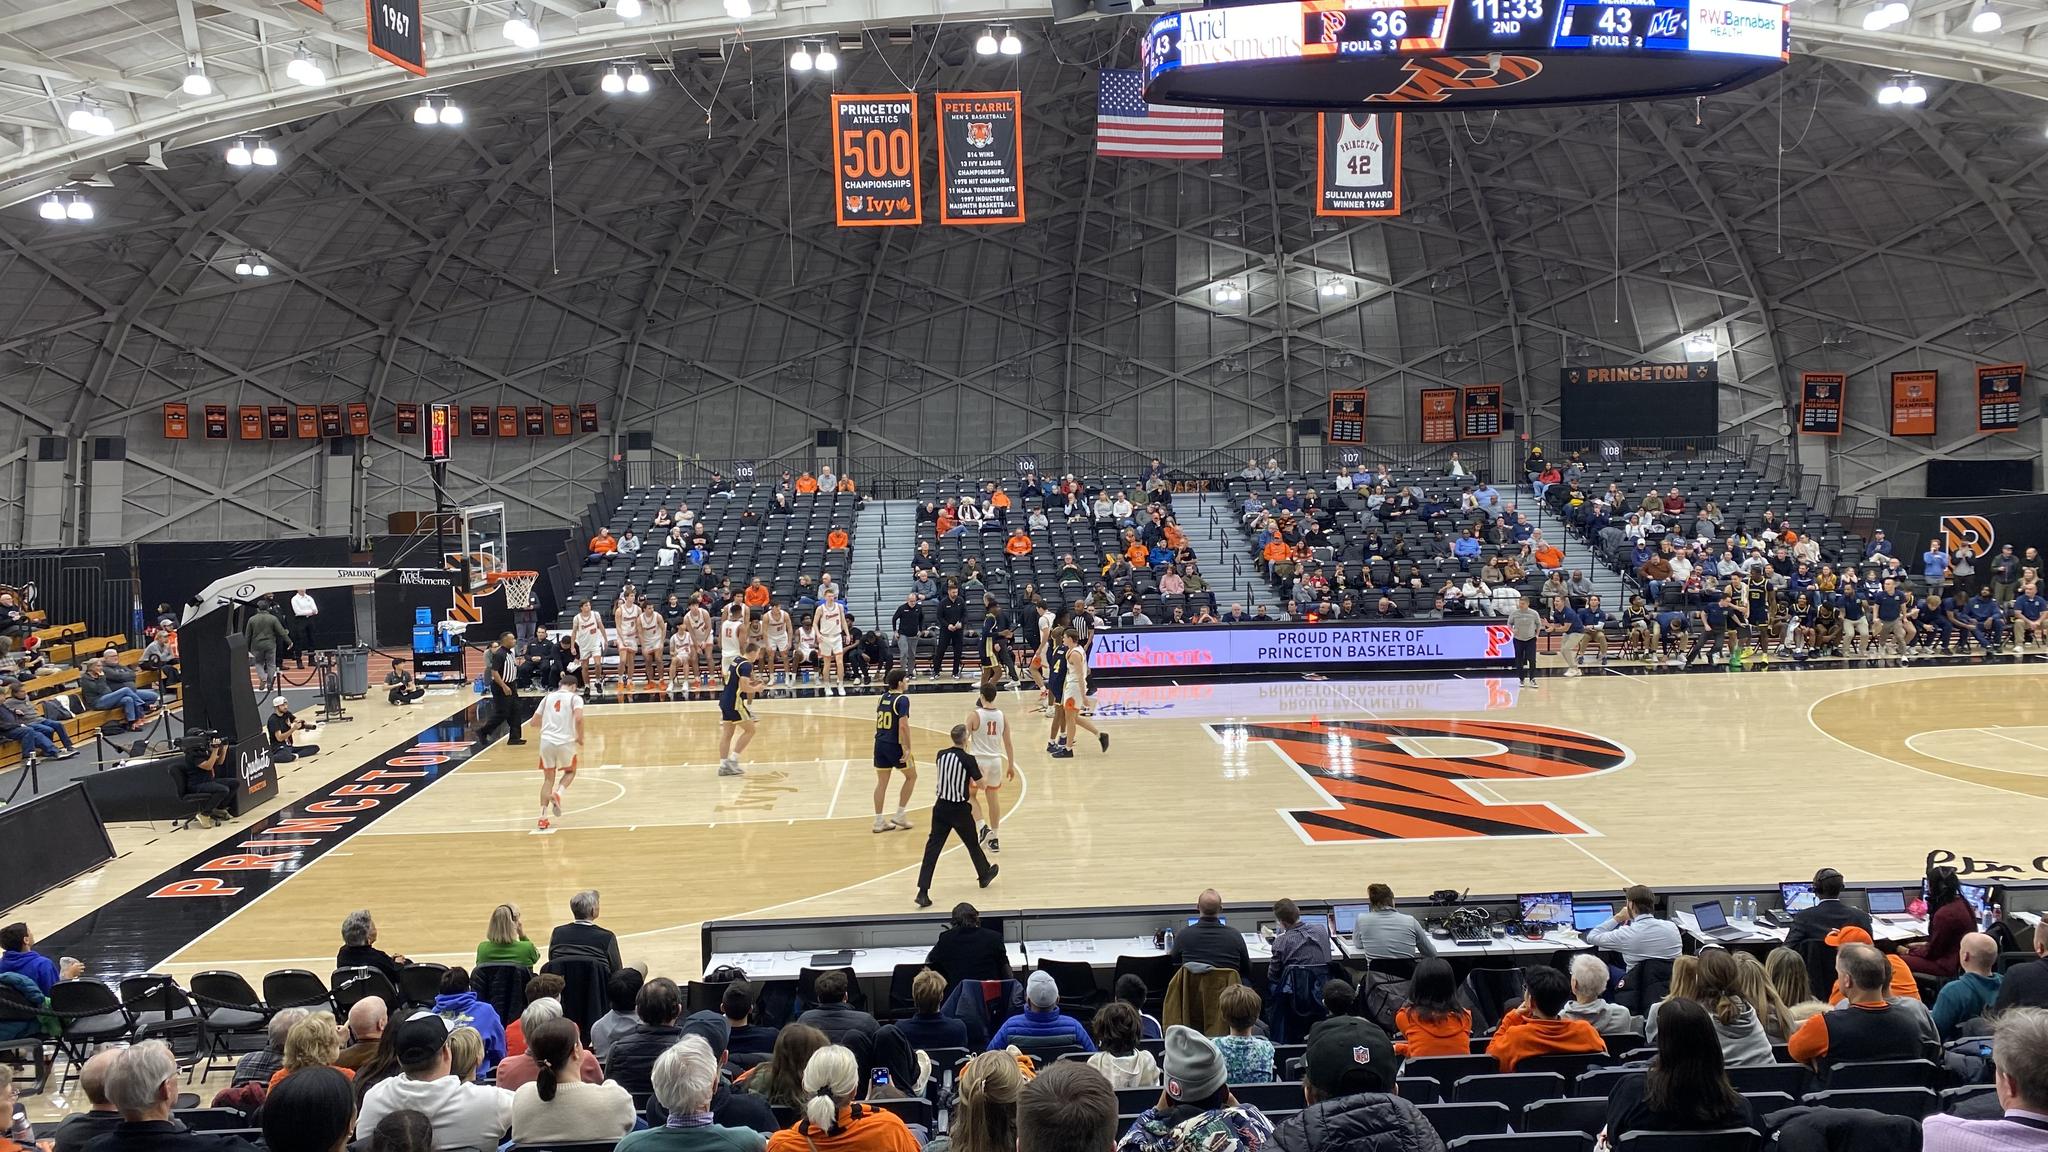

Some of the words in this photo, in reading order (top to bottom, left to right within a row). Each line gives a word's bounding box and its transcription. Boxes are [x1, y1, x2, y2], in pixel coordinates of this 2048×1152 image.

[1472, 0, 1543, 19] 11:33
[382, 4, 409, 37] 1967
[1371, 10, 1407, 37] 36
[1598, 6, 1632, 33] 43
[1700, 8, 1776, 31] RWJBarnabas
[1183, 11, 1227, 43] Ariel
[1492, 21, 1521, 34] 2ND
[1710, 27, 1743, 37] HEALTH
[1341, 40, 1382, 53] FOULS
[1389, 39, 1397, 49] 3
[1592, 36, 1630, 47] FOULS
[1634, 37, 1643, 47] 2
[840, 103, 911, 116] PRINCETON
[945, 103, 972, 112] PETE
[974, 102, 1013, 112] CARRIL
[852, 116, 899, 124] ATHLETICS
[843, 129, 911, 178] 500
[1340, 140, 1380, 153] PRINCETON
[1347, 155, 1371, 175] 42
[844, 180, 911, 189] CHAMPIONSHIPS
[1325, 191, 1363, 199] SULLIVAN
[1364, 190, 1393, 199] AWARD
[866, 196, 895, 216] Ivy
[1366, 200, 1385, 208] 1965
[1587, 365, 1689, 383] PRINCETON
[1343, 453, 1359, 462] 107
[1604, 447, 1620, 456] 108
[737, 467, 753, 477] 105
[1019, 461, 1034, 470] 106
[400, 577, 451, 586] Investments
[401, 570, 420, 580] Ariel
[1096, 634, 1140, 653] Ariel
[1278, 632, 1328, 645] PROUD
[1332, 630, 1401, 644] PARTNER
[1405, 630, 1424, 642] OF
[1096, 650, 1213, 667] Investments
[1258, 646, 1343, 660] PRINCETON
[1347, 644, 1444, 658] BASKETBALL
[554, 699, 561, 712] 4
[877, 711, 892, 729] 20
[986, 721, 996, 735] 11
[241, 747, 269, 787] Graduate
[146, 741, 477, 898] PRINCETON
